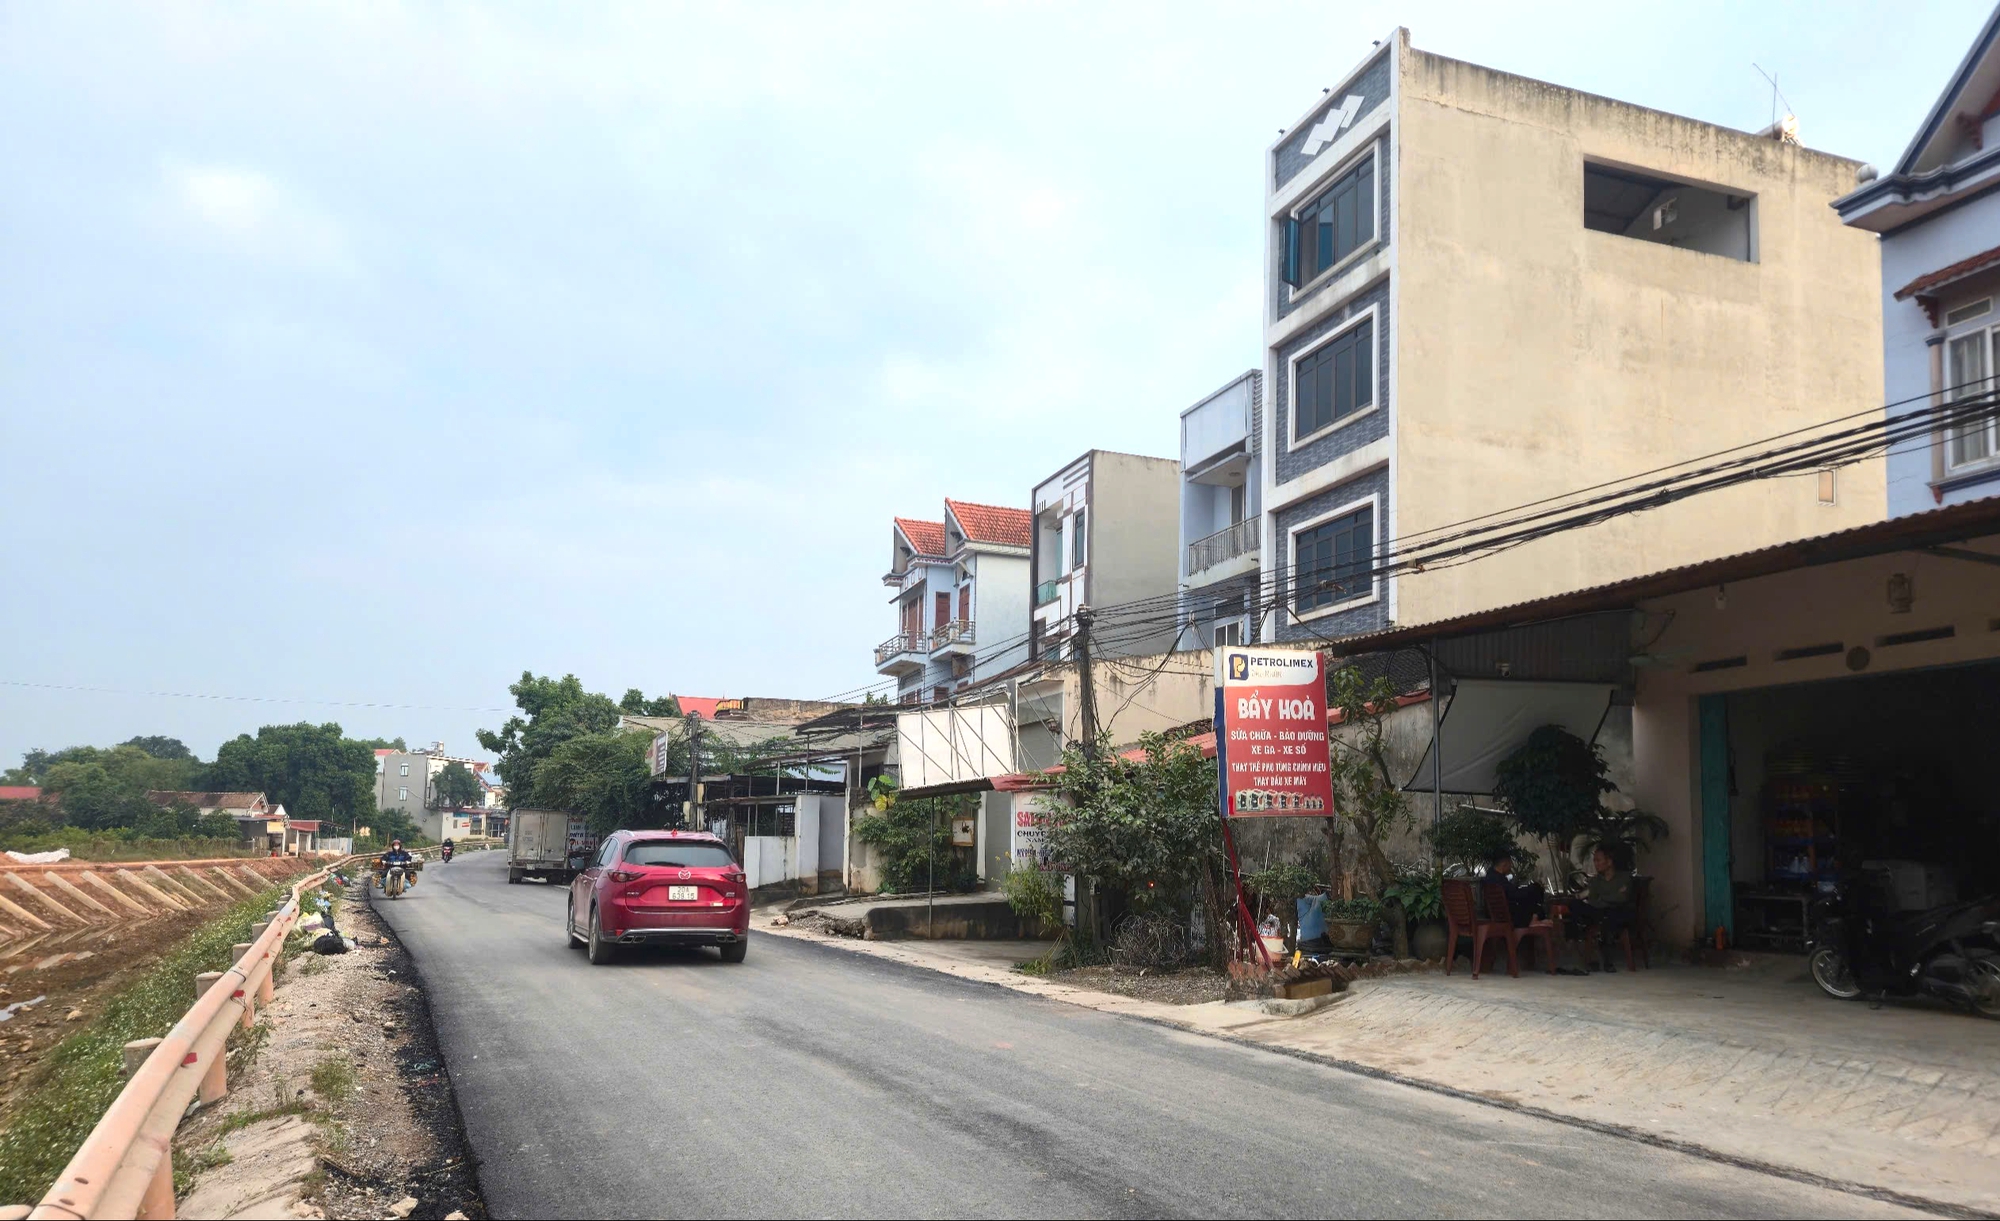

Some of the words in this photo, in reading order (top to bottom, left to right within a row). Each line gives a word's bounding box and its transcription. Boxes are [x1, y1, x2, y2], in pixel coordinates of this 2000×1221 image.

[1250, 656, 1314, 668] PETROLIMEX
[1238, 689, 1273, 719] BẨY
[1279, 695, 1316, 720] HOÀ
[1251, 745, 1262, 755] XE
[1264, 745, 1276, 755] GA
[1283, 745, 1293, 755] XE
[1295, 742, 1307, 755] SỐ
[1232, 762, 1248, 772] THAY
[1253, 776, 1269, 787] THAY
[1284, 776, 1292, 786] XE
